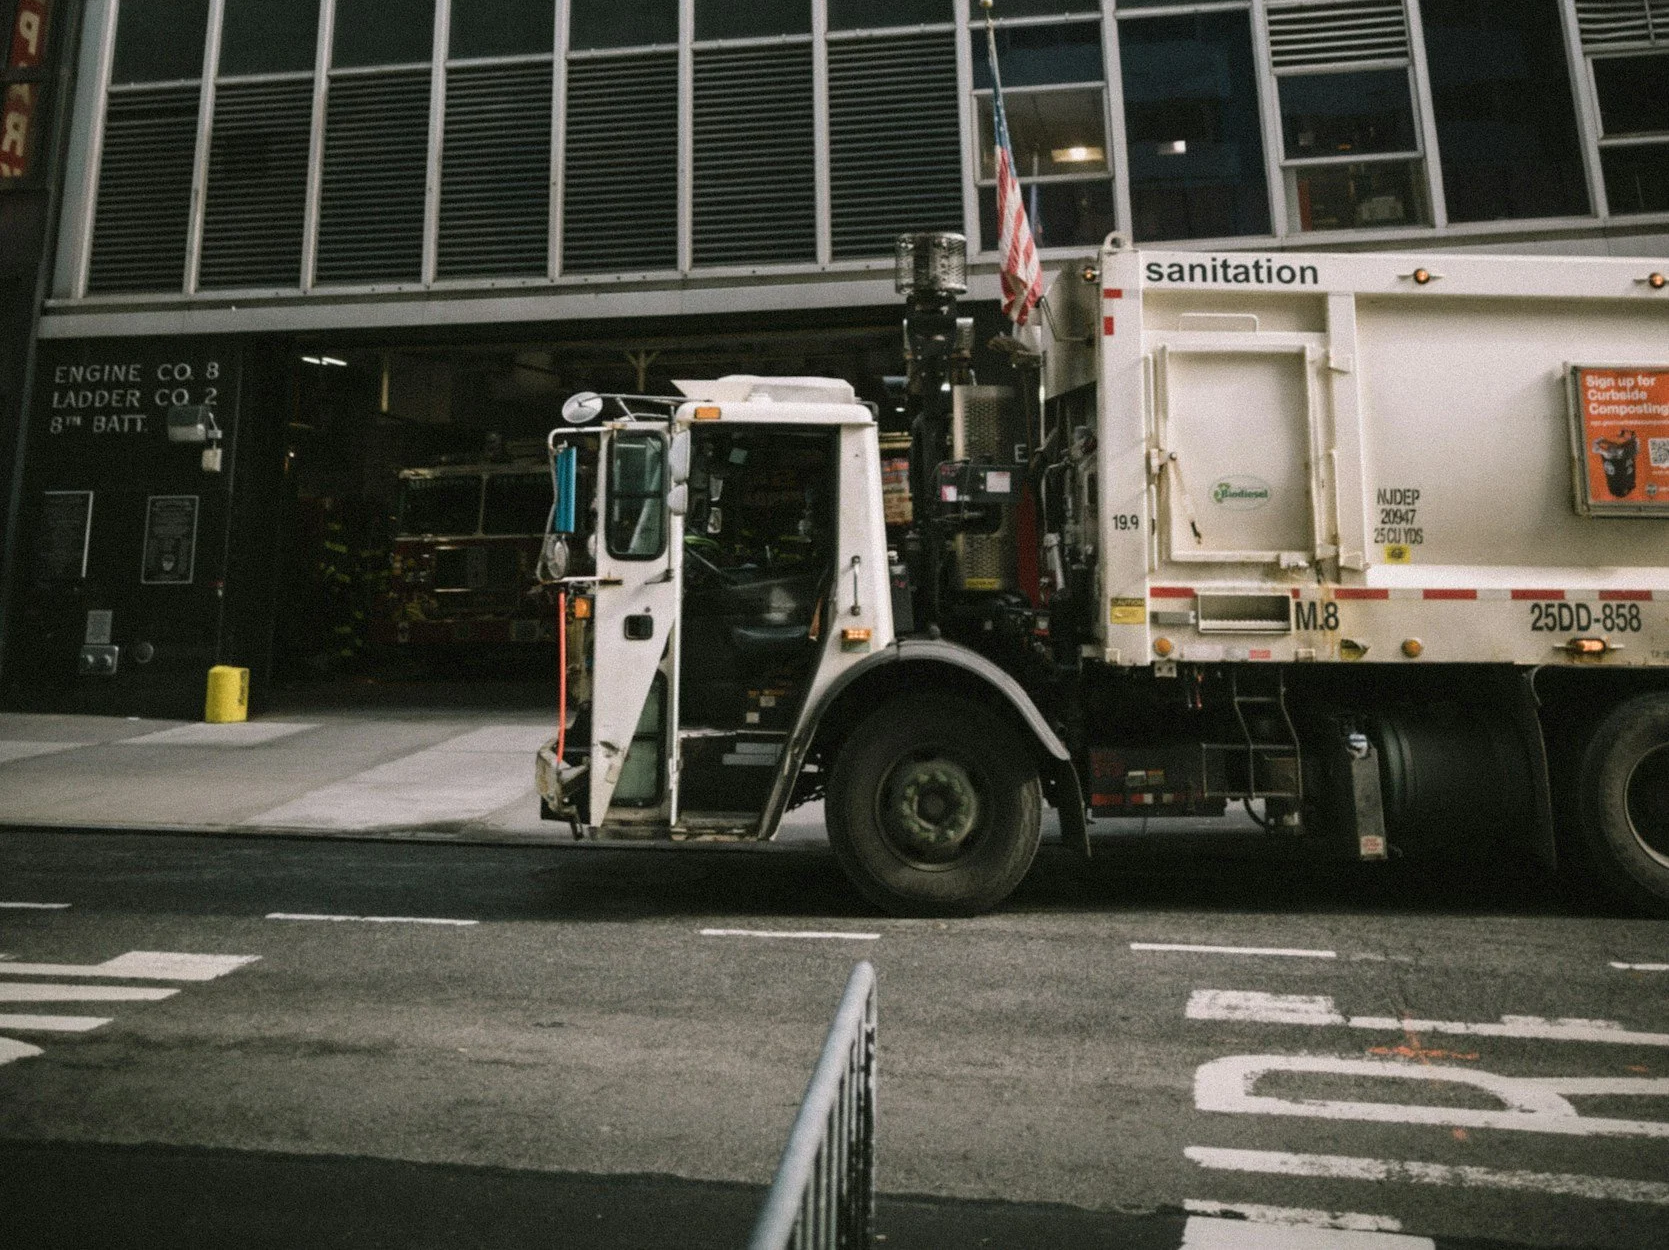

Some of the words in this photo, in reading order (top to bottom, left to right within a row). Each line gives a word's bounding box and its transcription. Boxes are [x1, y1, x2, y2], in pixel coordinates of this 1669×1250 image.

[1146, 257, 1319, 285] sanitation
[54, 363, 142, 384] ENGINE
[206, 361, 220, 380] 8
[1586, 375, 1615, 388] Sign
[1618, 376, 1634, 391] up
[1637, 374, 1656, 387] for
[52, 389, 141, 409] LADDER
[204, 387, 218, 406] 2
[1587, 389, 1648, 401] Curbside
[1220, 487, 1269, 499] Biodiesel
[1377, 488, 1420, 505] NJDEP
[1112, 513, 1140, 531] 19.9
[1381, 508, 1416, 525] 20947
[1374, 528, 1385, 543] 25
[1387, 528, 1401, 543] CU
[1404, 528, 1423, 544] YDS
[1530, 601, 1642, 634] 25DD-858
